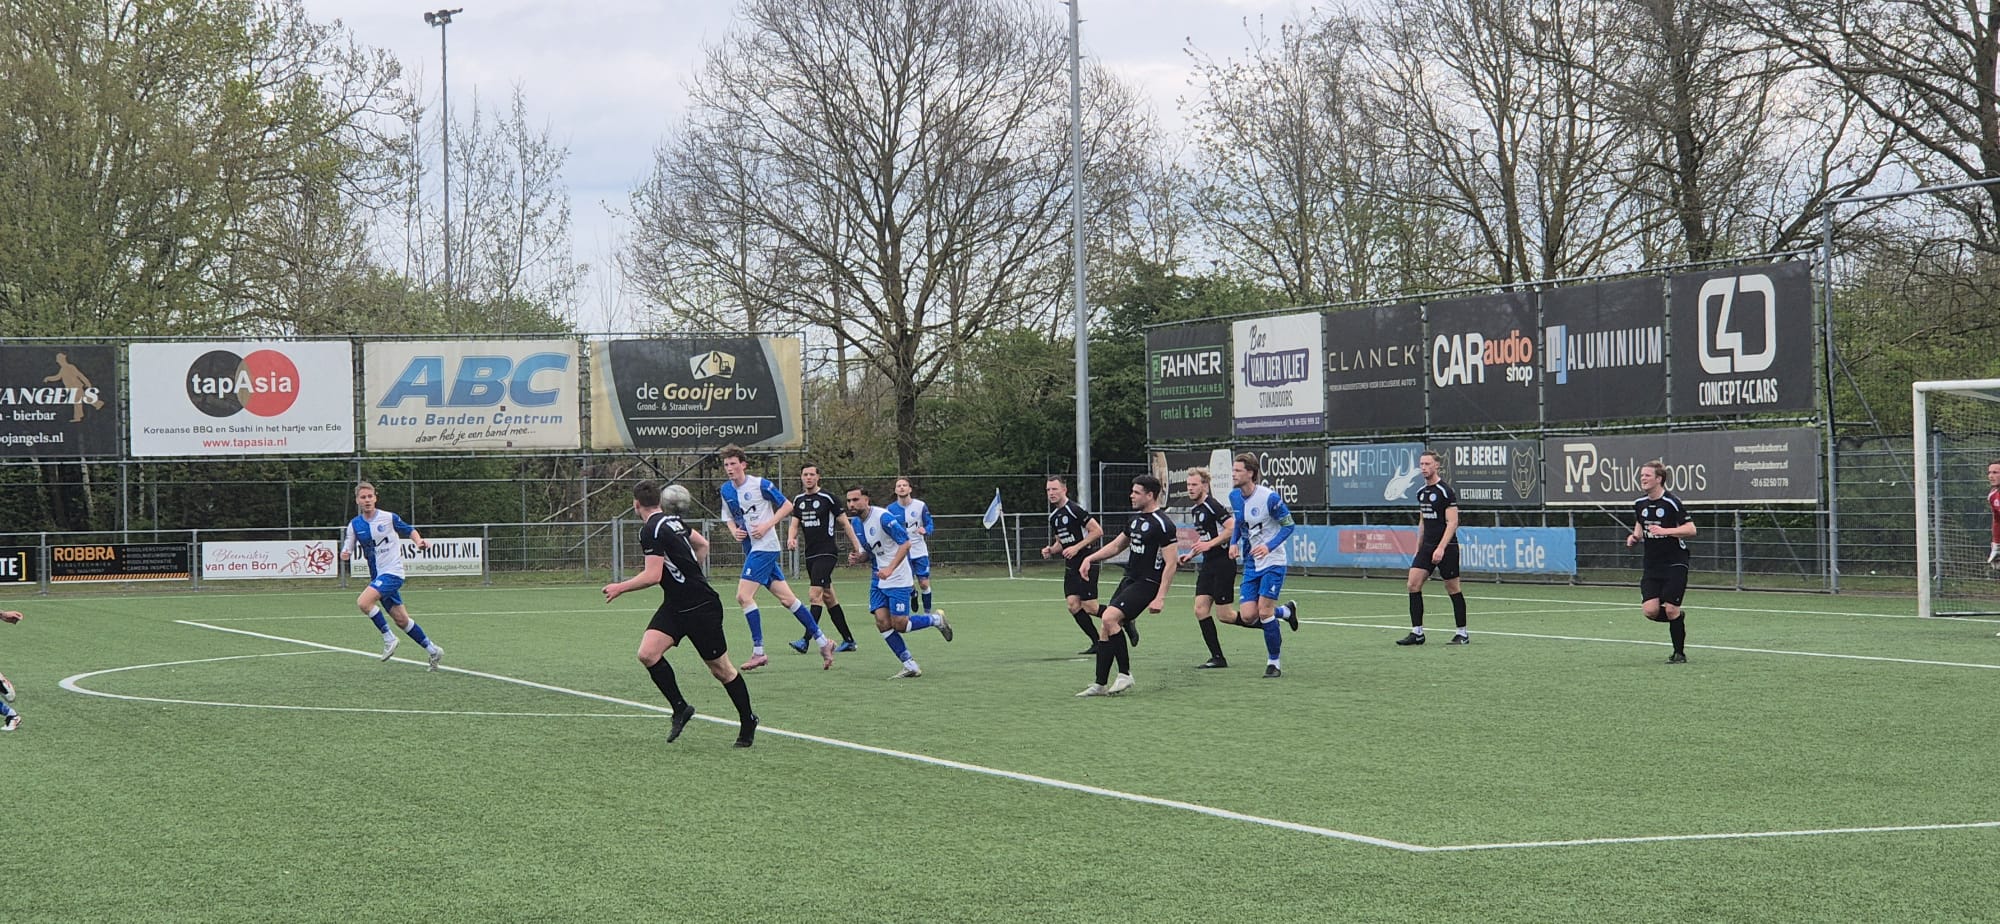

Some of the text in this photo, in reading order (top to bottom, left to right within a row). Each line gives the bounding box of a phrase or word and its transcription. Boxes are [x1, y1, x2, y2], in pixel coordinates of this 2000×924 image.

[1328, 345, 1416, 372] CLANCK
[1568, 326, 1661, 371] ALUMINIUM
[1161, 351, 1221, 378] FAHNER
[1250, 353, 1306, 382] VAN DER VLIET
[1506, 363, 1533, 387] shop
[192, 370, 292, 399] tapAsia
[376, 351, 571, 408] ABC
[0, 387, 100, 405] ANGELS
[636, 382, 758, 411] de Gooijer bv
[1259, 390, 1293, 408] STUKADOORS
[1699, 377, 1778, 406] CONCEPT4CARS
[13, 410, 57, 420] bierbar
[637, 402, 704, 411] Grond- & Straatwerk
[1161, 403, 1212, 419] rental & sales
[143, 426, 190, 434] Koreaanse
[192, 425, 213, 434] BBQ
[228, 425, 253, 433] Sushi
[281, 424, 303, 434] hartje
[377, 412, 563, 426] Auto Banden Centrum
[0, 432, 64, 447] ojangels.nl
[415, 430, 437, 443] daar
[439, 428, 454, 441] heb
[452, 430, 465, 445] je
[467, 431, 483, 439] een
[485, 424, 510, 437] band
[636, 422, 758, 438] www.gooijer-gsw.nl
[202, 437, 287, 449] www.tapasia.nl
[1260, 450, 1317, 476] Crossbow
[1455, 446, 1507, 466] DE BEREN
[1600, 457, 1706, 492] Stukoors
[1261, 478, 1298, 503] ffee
[1460, 488, 1503, 500] RESTAURANT EDE
[54, 546, 115, 561] ROBBRA
[1292, 535, 1317, 562] Ede
[1515, 536, 1545, 568] Ede
[205, 561, 278, 571] van den Born
